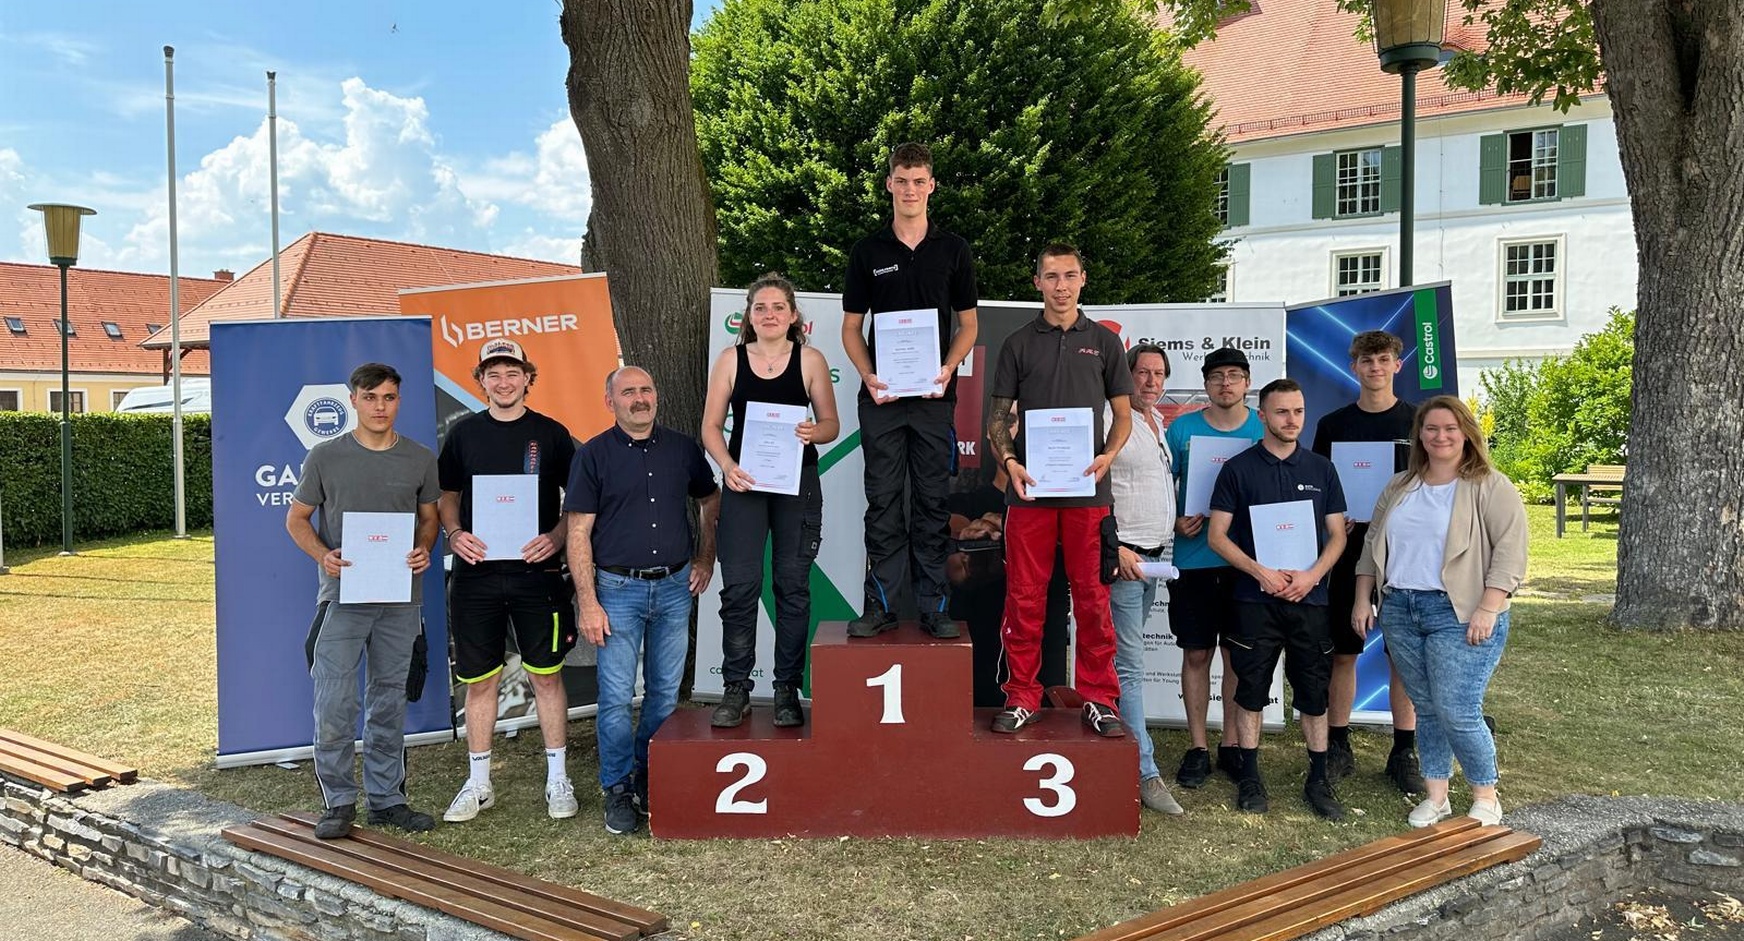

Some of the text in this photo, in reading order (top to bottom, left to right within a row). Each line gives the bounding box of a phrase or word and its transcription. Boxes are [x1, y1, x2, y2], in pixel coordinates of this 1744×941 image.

[465, 313, 579, 340] BERNER
[1201, 336, 1214, 350] &
[1222, 336, 1271, 350] Klein
[1421, 322, 1435, 364] Castrol
[866, 664, 906, 724] 1
[715, 752, 768, 814] 2
[1022, 753, 1077, 818] 3
